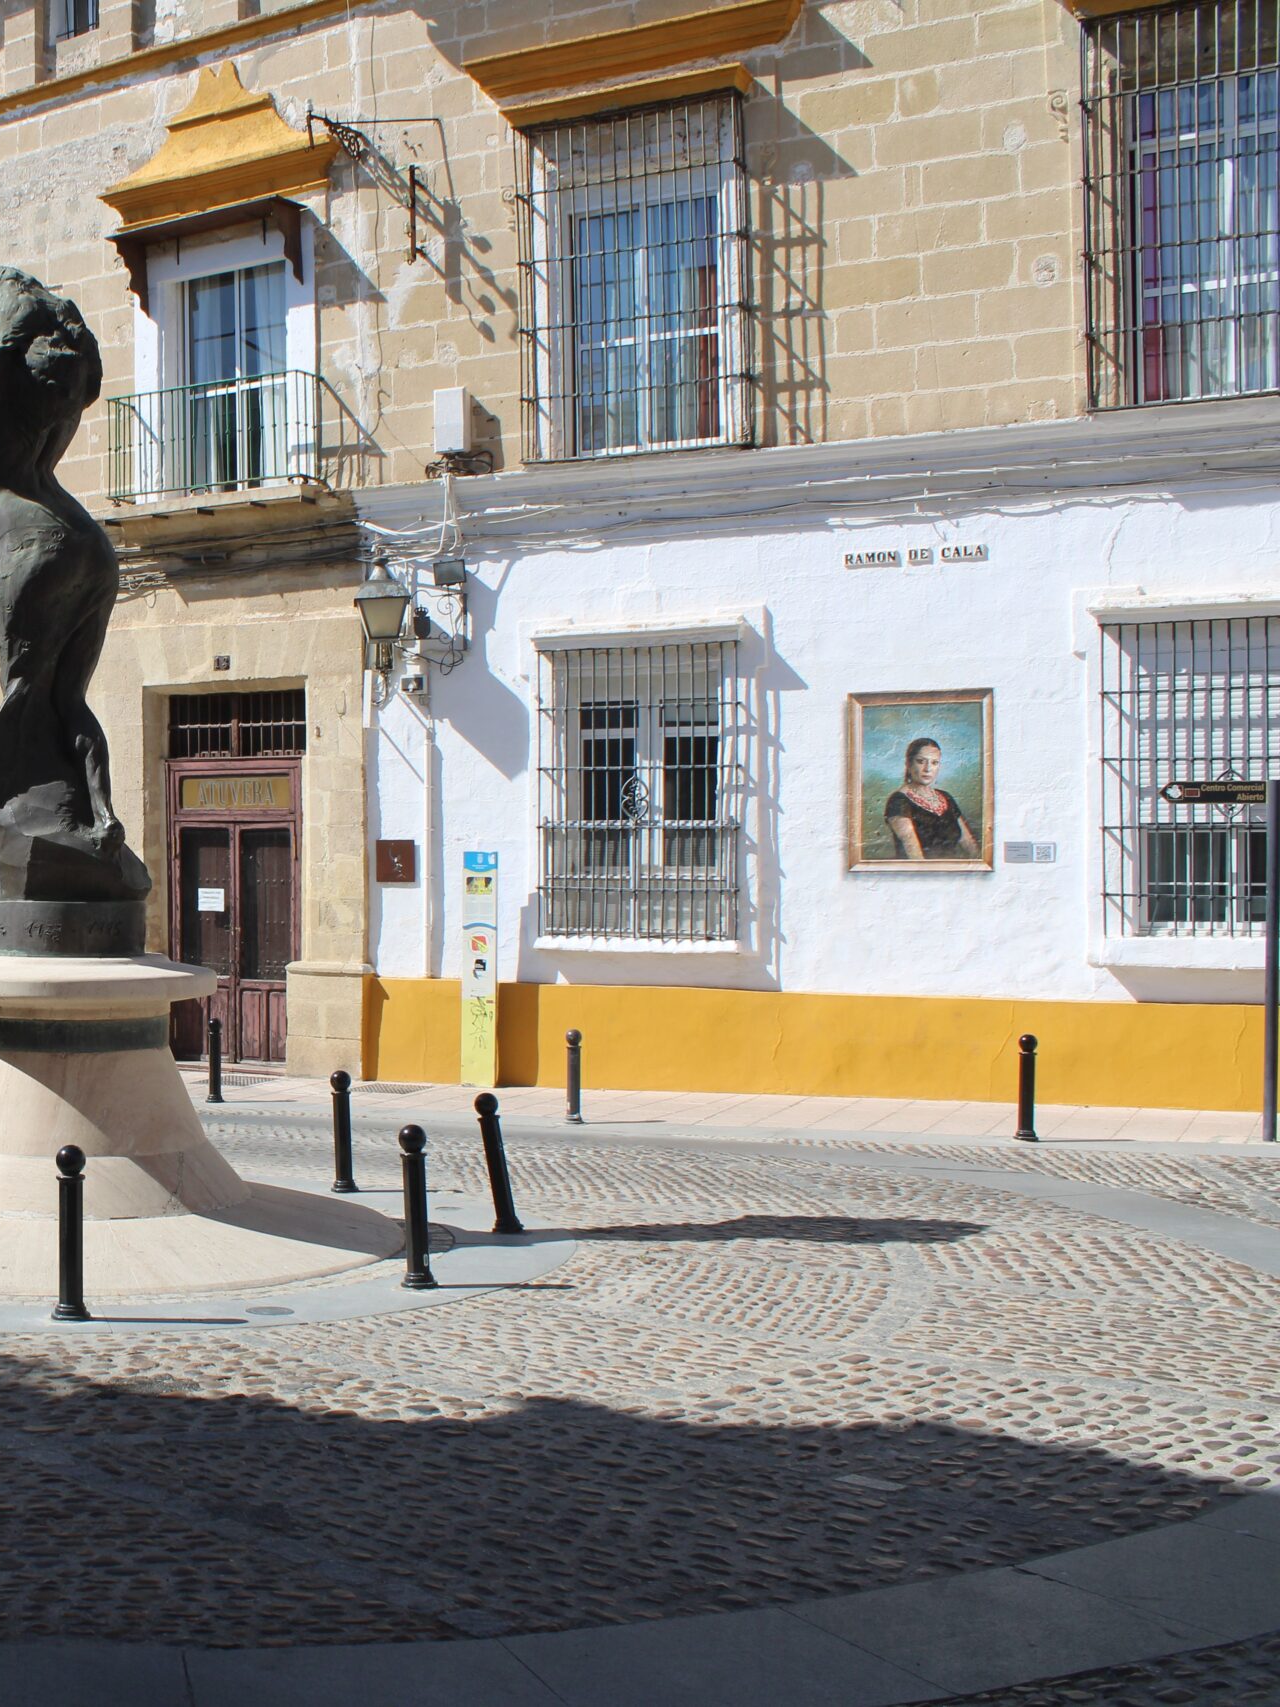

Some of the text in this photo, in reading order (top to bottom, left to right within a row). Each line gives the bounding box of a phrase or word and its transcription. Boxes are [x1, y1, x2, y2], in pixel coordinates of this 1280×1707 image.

[844, 545, 985, 565] RAMON DE CALA
[199, 780, 275, 805] ATUVERA
[1200, 783, 1264, 792] Centro Comercial
[1236, 793, 1264, 801] Abierto
